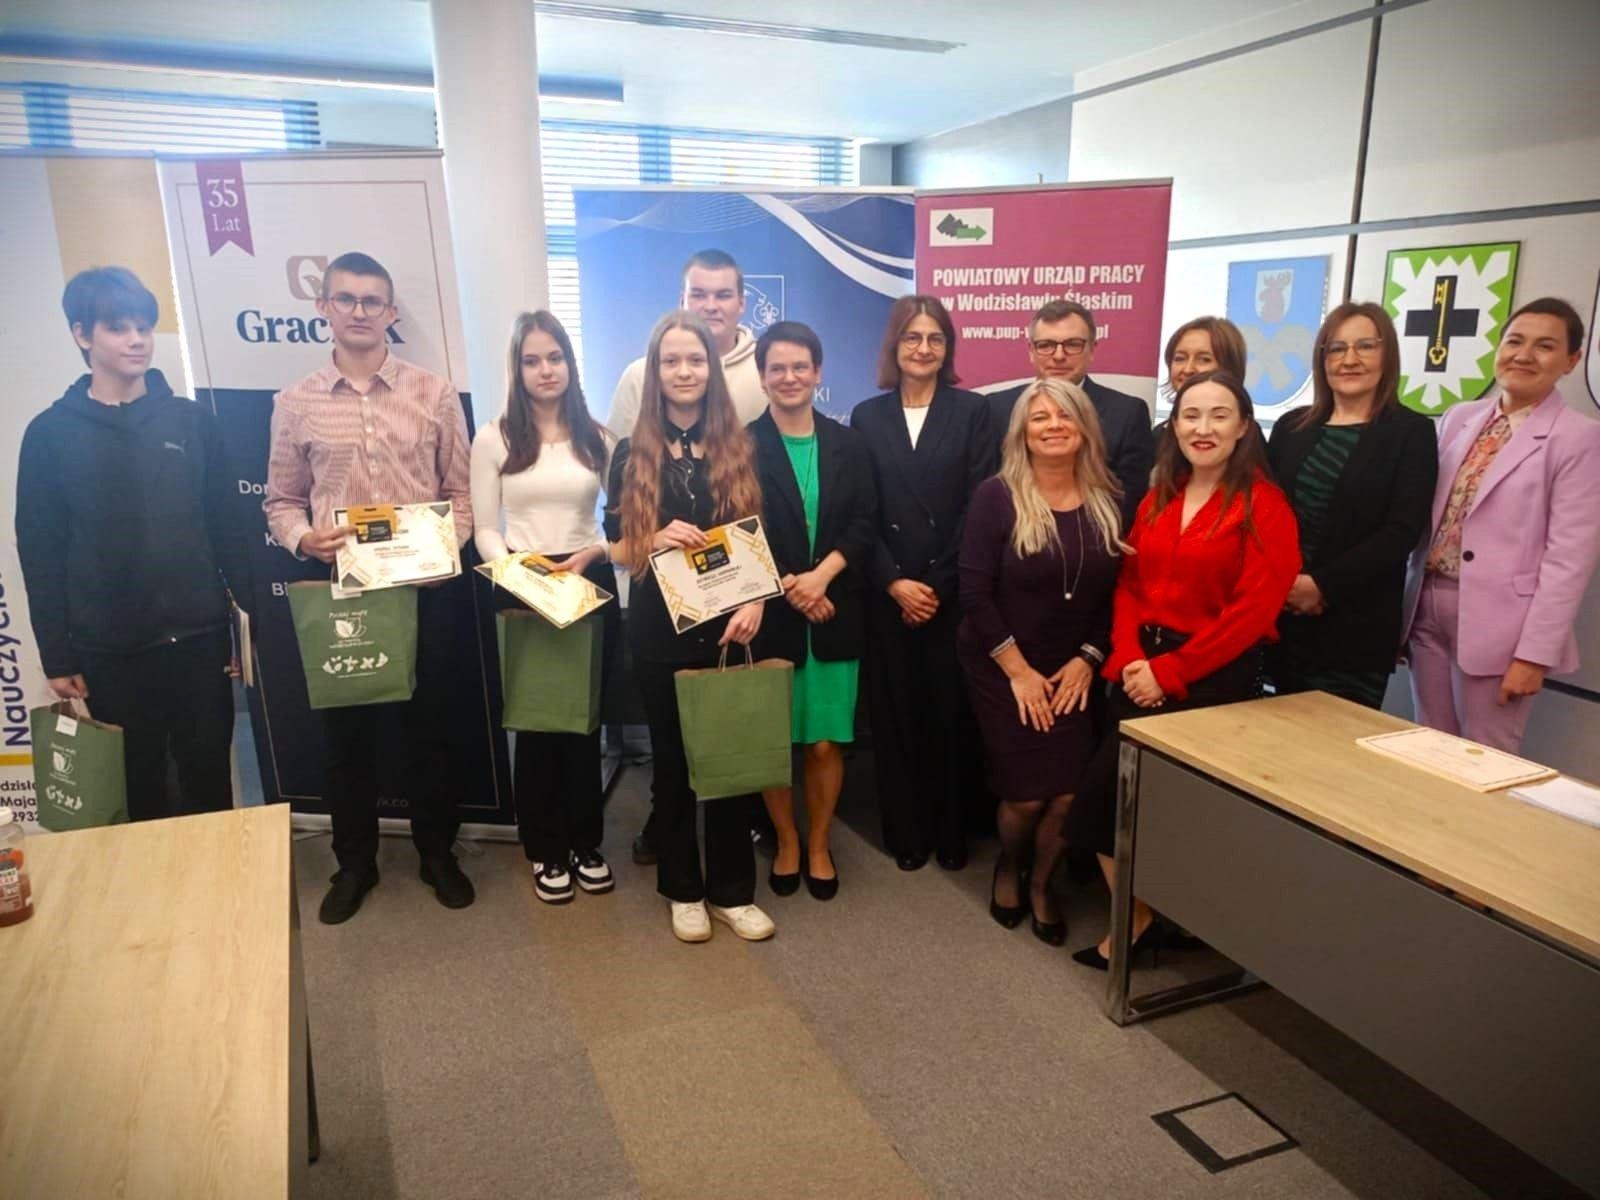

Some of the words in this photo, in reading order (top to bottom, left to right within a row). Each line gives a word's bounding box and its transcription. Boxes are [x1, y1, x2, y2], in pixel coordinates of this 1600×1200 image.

[206, 178, 238, 208] 35
[211, 213, 241, 232] Lat
[932, 267, 1030, 287] POWIATOWY
[1033, 266, 1085, 288] URZĄD
[1089, 264, 1145, 284] PRACY
[940, 297, 954, 312] w
[236, 310, 405, 343] Grack
